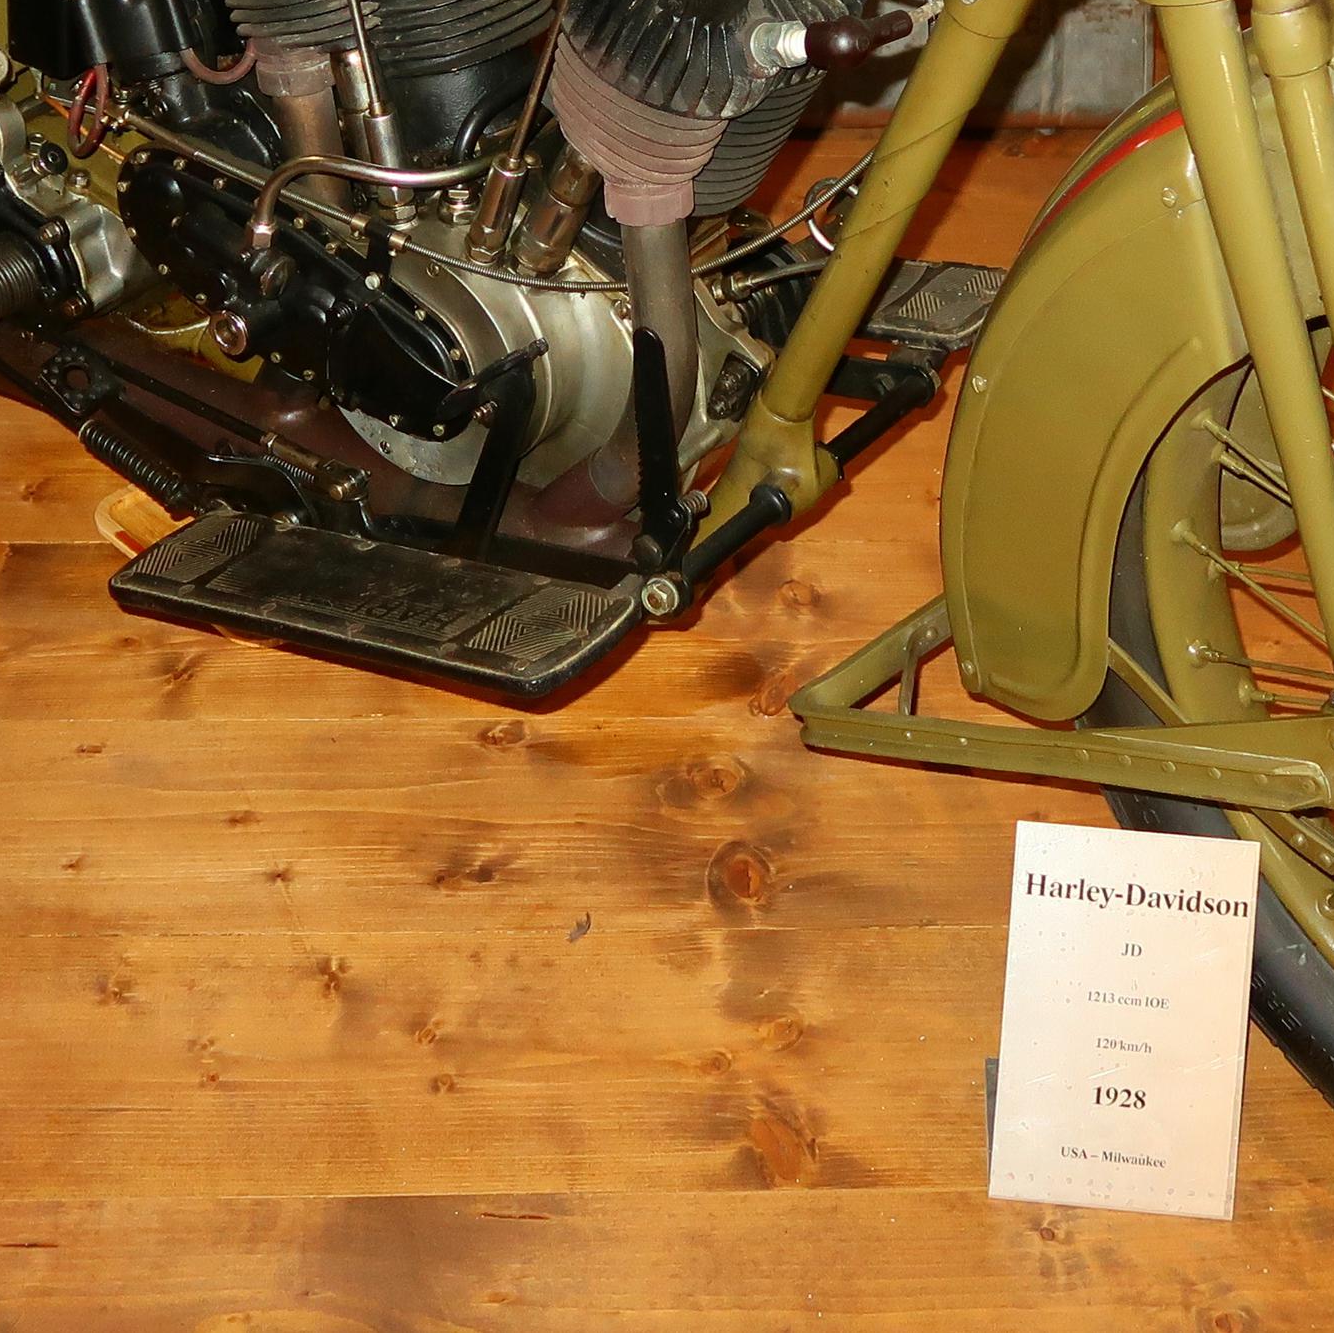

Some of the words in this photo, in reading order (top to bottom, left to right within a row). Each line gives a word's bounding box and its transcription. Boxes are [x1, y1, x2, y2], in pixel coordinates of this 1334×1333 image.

[1025, 872, 1250, 918] Harley-Davidson
[1121, 943, 1143, 958] JD
[1087, 990, 1116, 1005] 1213
[1118, 995, 1142, 1008] ccm
[1144, 995, 1170, 1010] IOE
[1095, 1037, 1118, 1052] 120
[1119, 1039, 1153, 1055] km/h
[1093, 1085, 1147, 1110] 1928
[1061, 1145, 1089, 1161] USA
[1101, 1150, 1167, 1169] Milwaukee
